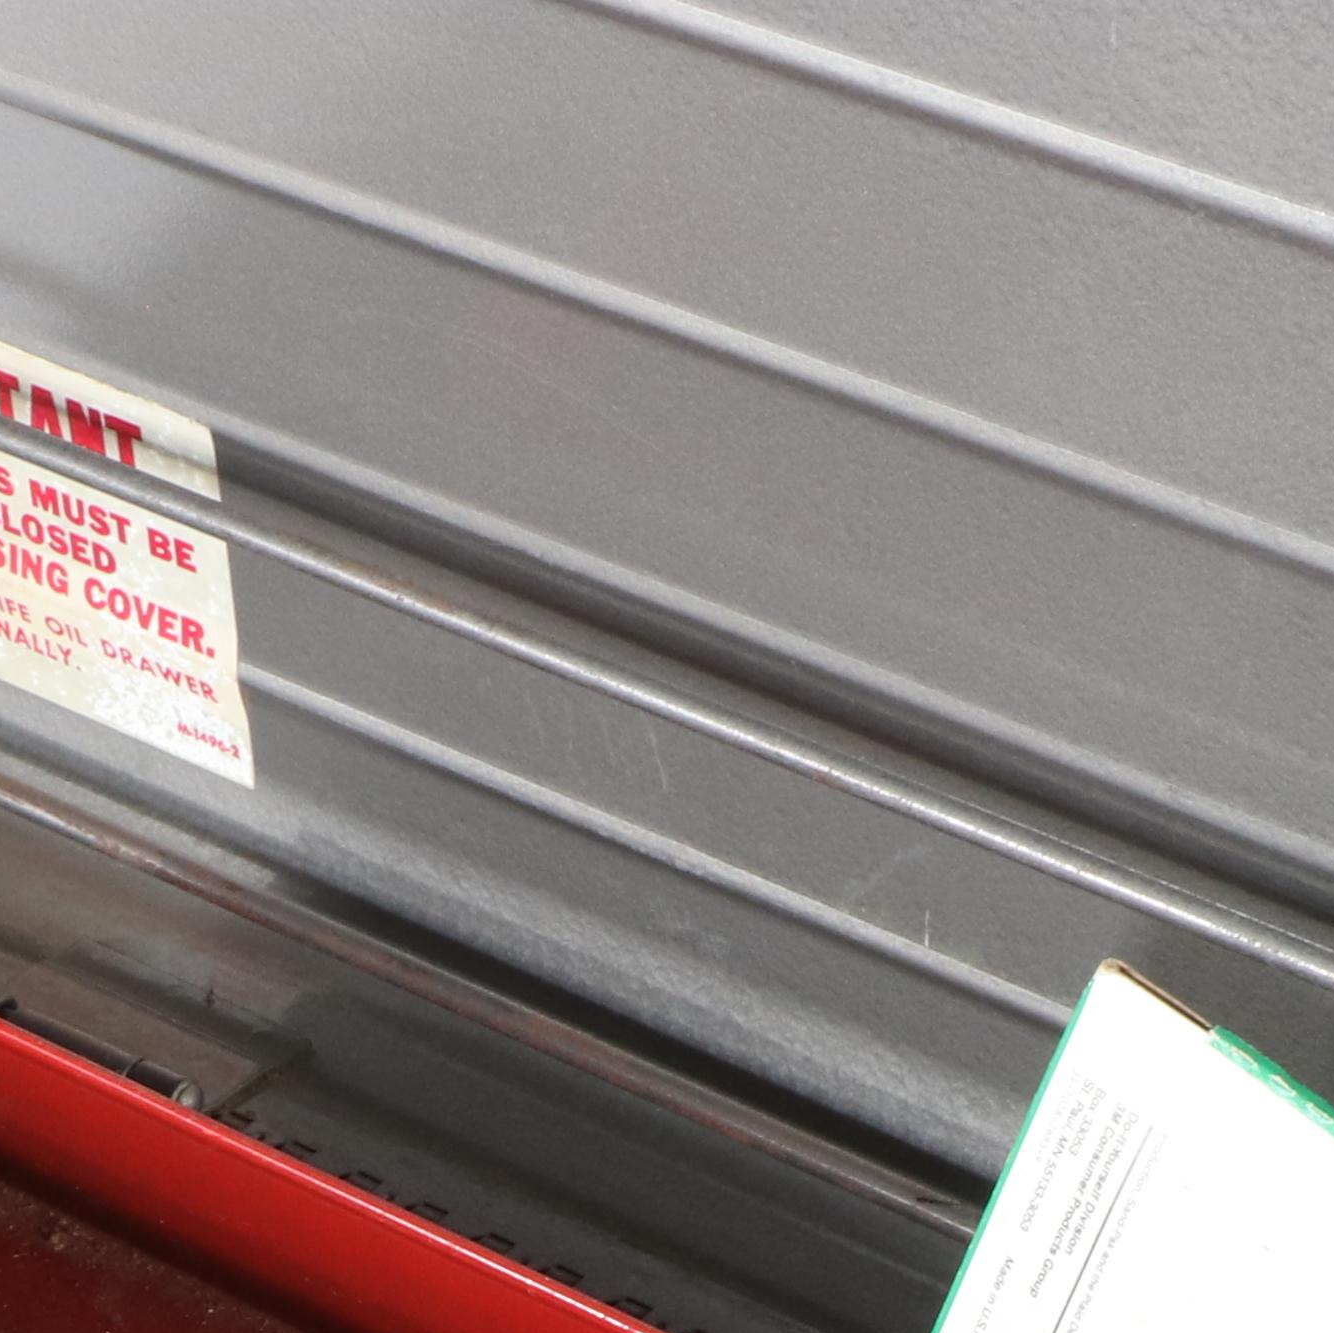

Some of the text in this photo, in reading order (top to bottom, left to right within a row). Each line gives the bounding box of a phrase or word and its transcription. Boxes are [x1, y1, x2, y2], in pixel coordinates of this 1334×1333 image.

[29, 479, 130, 544] MUST
[148, 526, 196, 573] BE
[84, 578, 215, 658] COVER.
[45, 616, 87, 646] OIL
[102, 640, 218, 704] DRAWER
[1067, 1087, 1108, 1157] Box 33053
[1110, 1102, 1127, 1126] 3M
[1051, 1135, 1069, 1159] MN
[1076, 1126, 1116, 1197] Consumer
[1018, 1159, 1058, 1233] 55133-3053
[1048, 1196, 1082, 1256] Products
[1064, 1200, 1096, 1256] Division
[986, 1291, 997, 1306] in
[993, 1255, 1015, 1291] Made
[1028, 1256, 1055, 1299] Group
